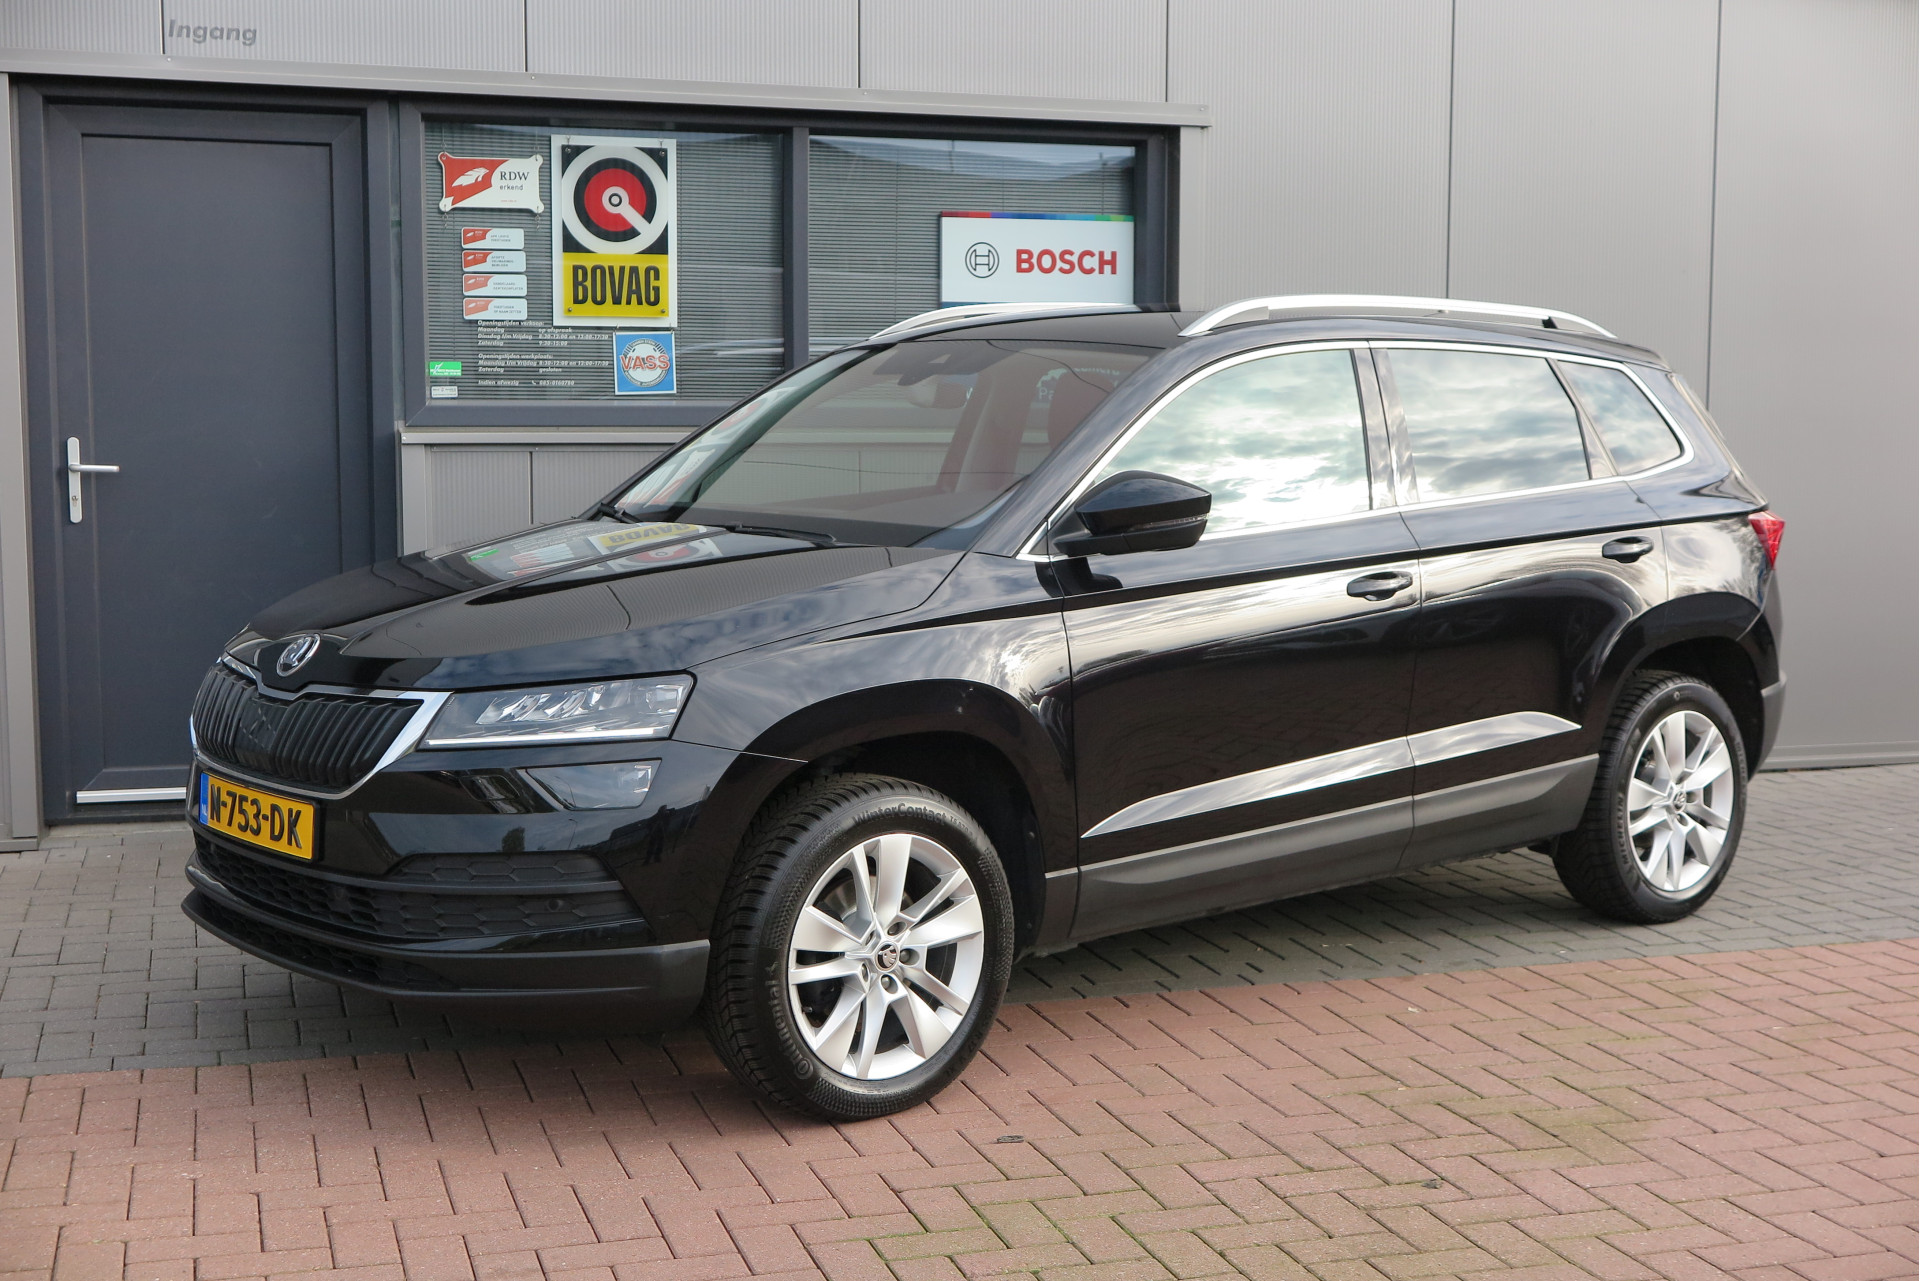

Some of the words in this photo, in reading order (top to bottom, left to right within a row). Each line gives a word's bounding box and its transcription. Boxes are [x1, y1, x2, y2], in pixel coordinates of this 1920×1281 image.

[168, 19, 257, 46] Ingang
[500, 171, 529, 181] RDW
[1016, 249, 1117, 275] BOSCH
[572, 264, 660, 306] BOVAG
[620, 354, 670, 370] VASS
[210, 783, 303, 849] N-753-DK
[852, 802, 947, 826] WinterContact
[1616, 795, 1629, 865] MICHELIN
[765, 980, 814, 1079] Continental
